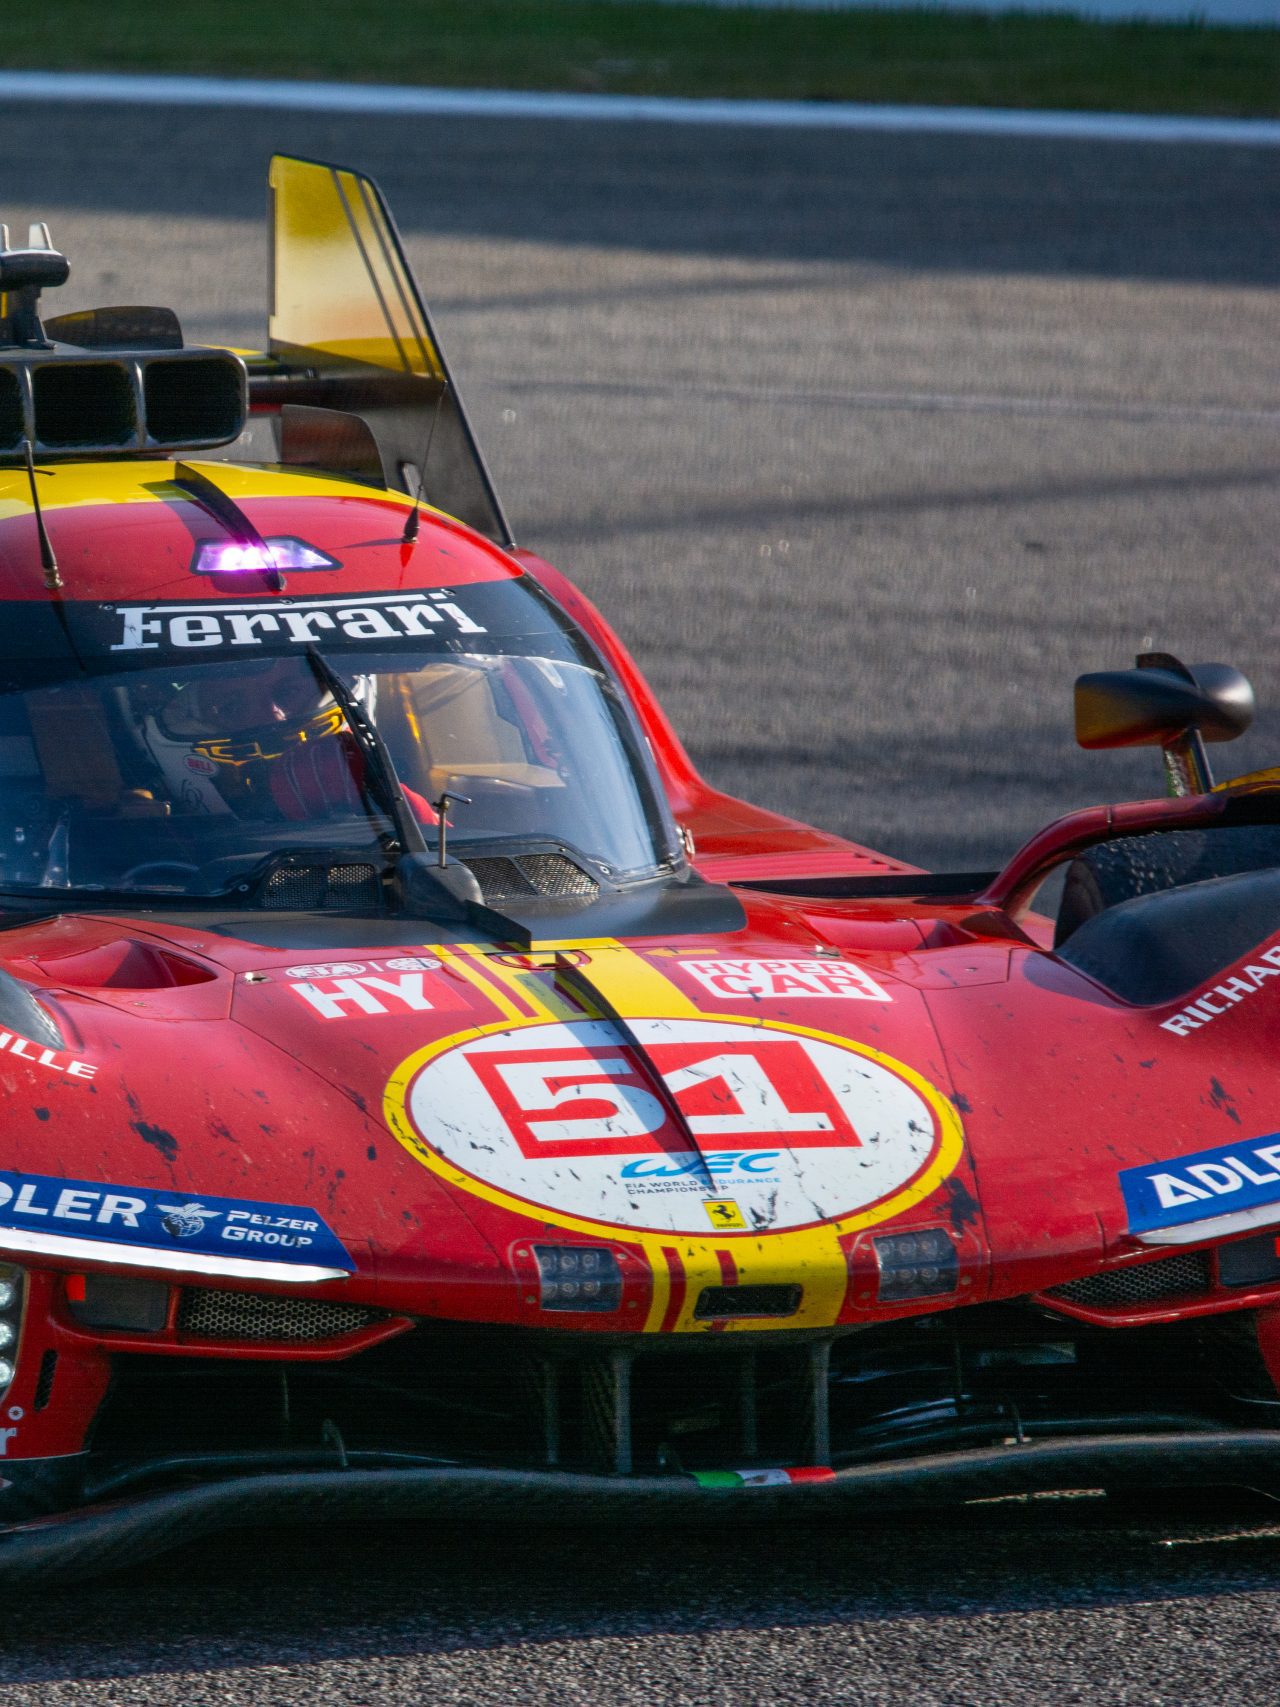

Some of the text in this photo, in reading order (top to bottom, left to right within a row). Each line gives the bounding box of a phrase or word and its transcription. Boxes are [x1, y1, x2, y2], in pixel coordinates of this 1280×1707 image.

[110, 592, 488, 651] Ferrari
[690, 961, 856, 976] HYPER
[288, 972, 436, 1019] HY
[709, 974, 877, 997] CAR
[491, 1052, 837, 1142] 51
[620, 1152, 780, 1179] WEC
[649, 1180, 698, 1188] WORLD
[225, 1209, 318, 1232] PELZER
[221, 1226, 313, 1248] GROUP
